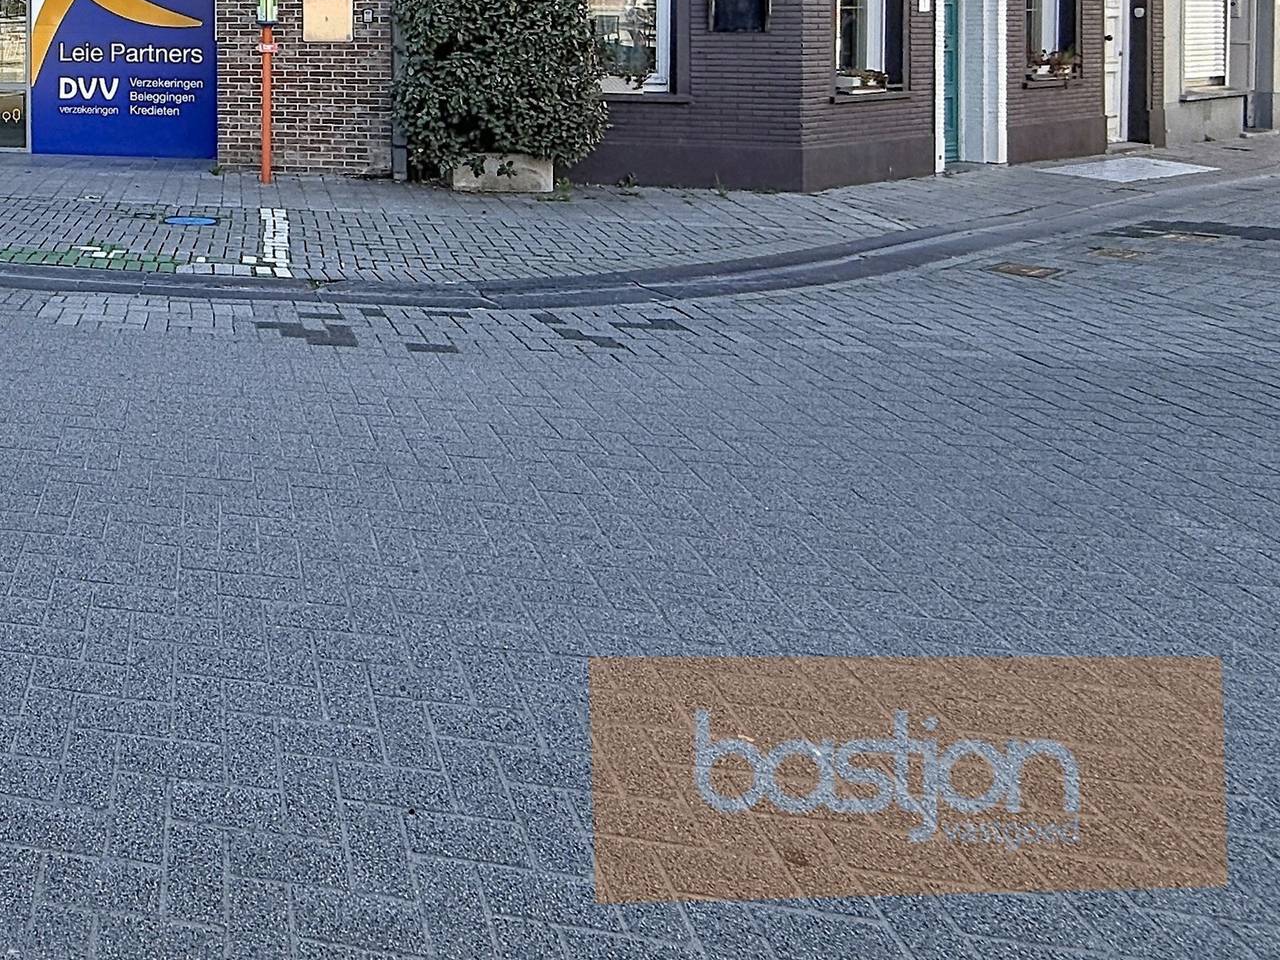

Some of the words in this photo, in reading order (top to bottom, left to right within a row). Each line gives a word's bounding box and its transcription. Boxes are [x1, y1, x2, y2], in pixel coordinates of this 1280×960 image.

[59, 42, 103, 62] Leie
[111, 43, 204, 64] Partners
[59, 77, 119, 100] DVV
[129, 77, 204, 91] Verzekeringen
[129, 92, 195, 105] Beleggingen
[59, 105, 119, 116] verzekeringen
[129, 105, 180, 117] Kredieten
